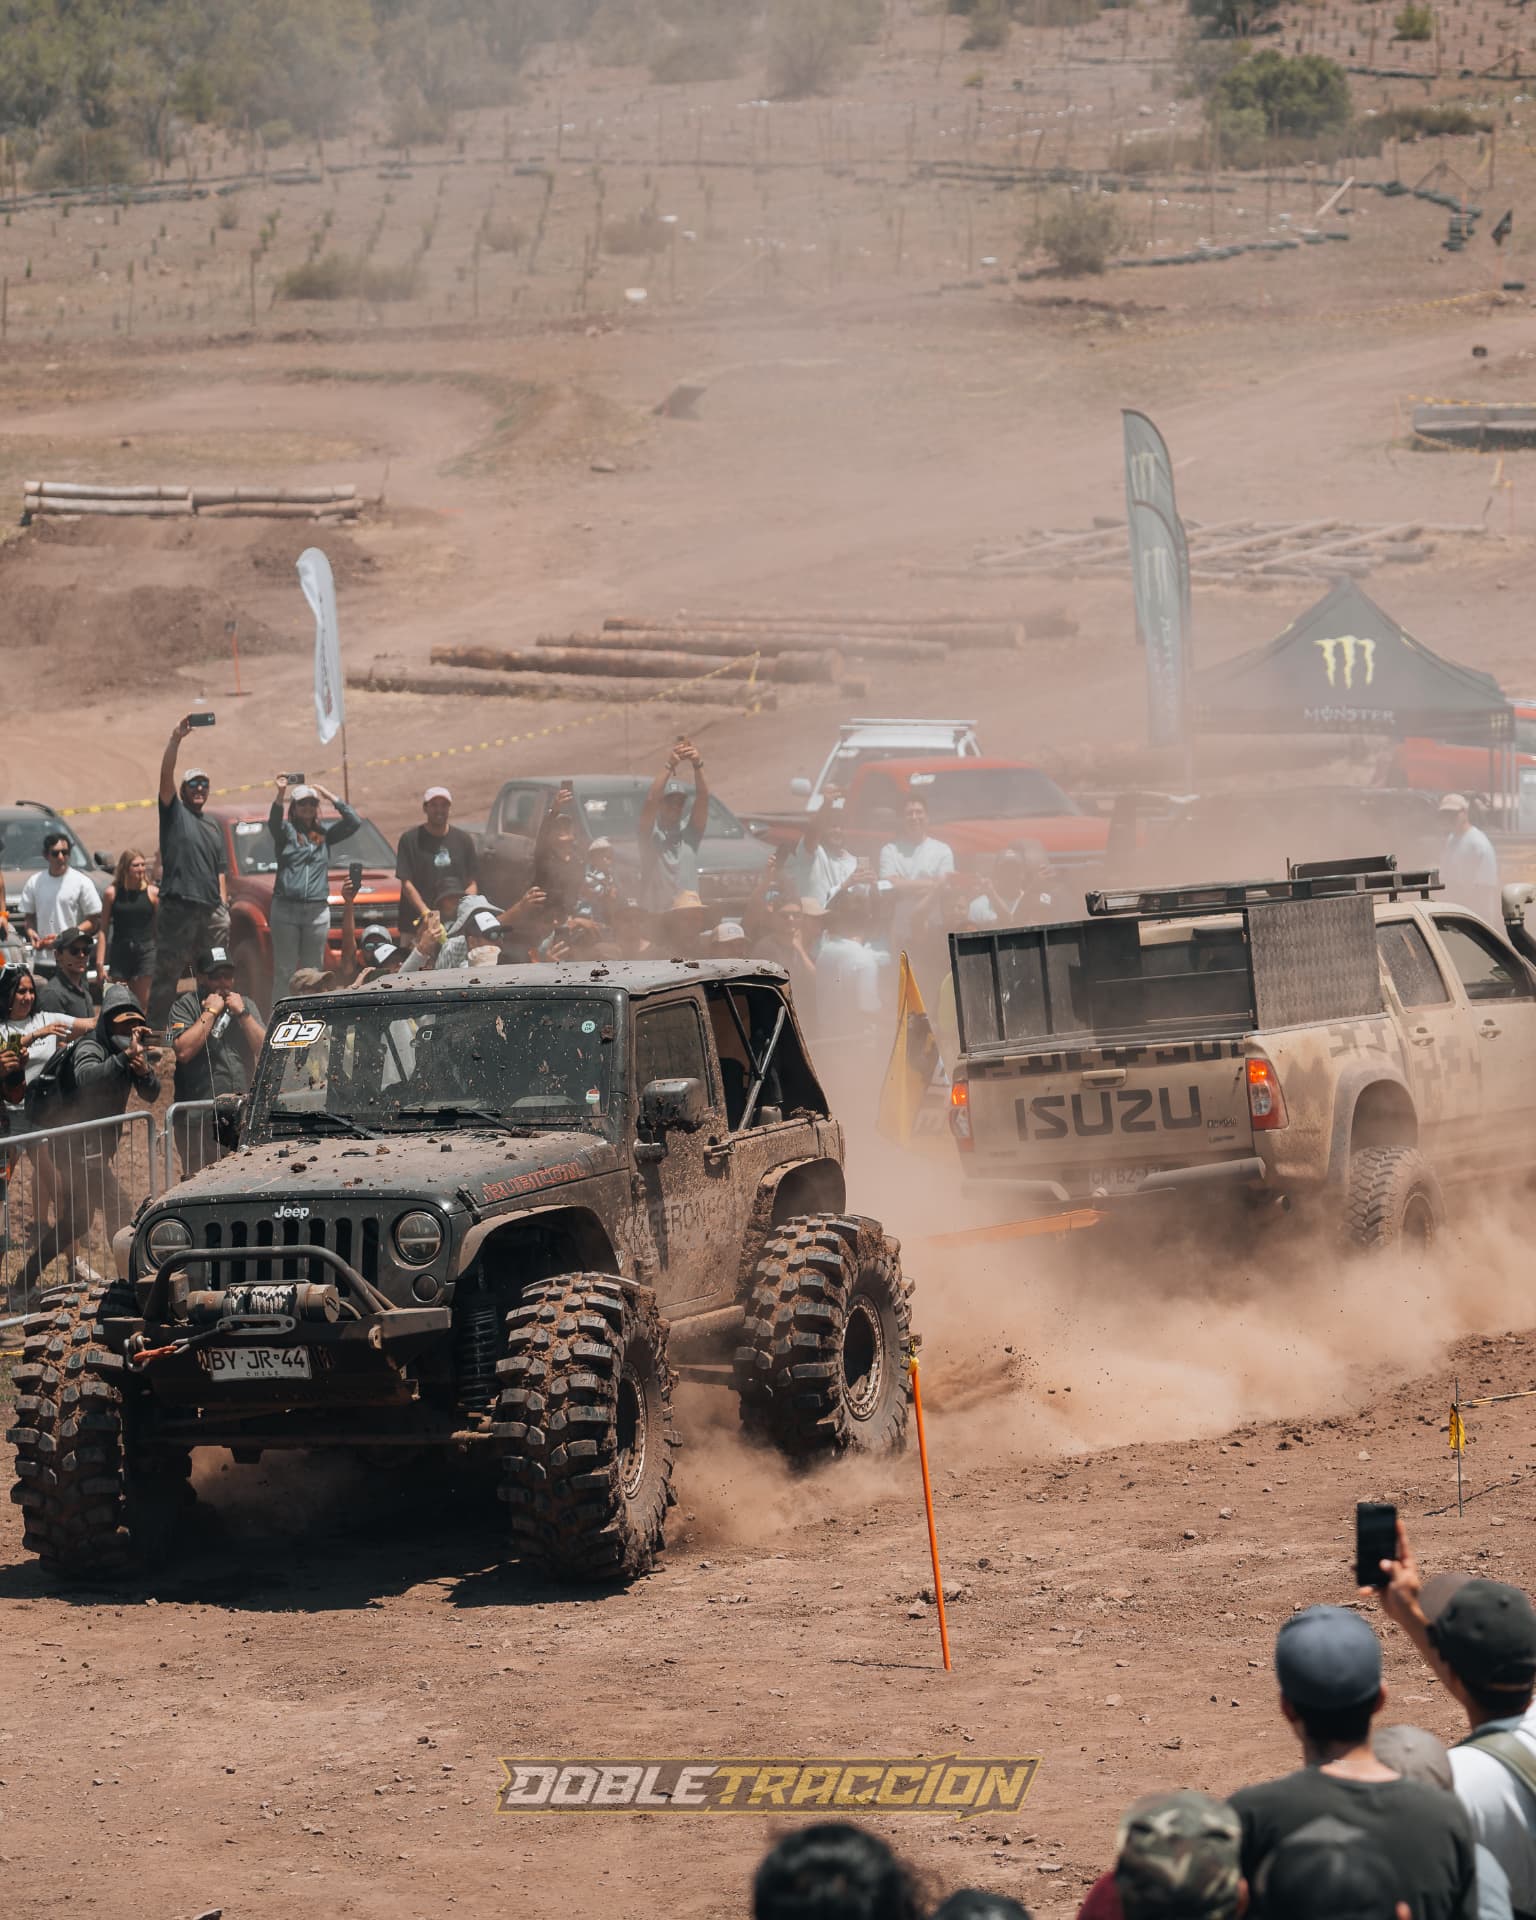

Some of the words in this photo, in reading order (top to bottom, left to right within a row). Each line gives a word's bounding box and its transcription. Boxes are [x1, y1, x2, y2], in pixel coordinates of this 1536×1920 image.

[273, 1023, 323, 1042] 09
[1015, 1085, 1203, 1142] ISUZU
[482, 1162, 586, 1202] RUBICON
[274, 1205, 310, 1220] Jeep
